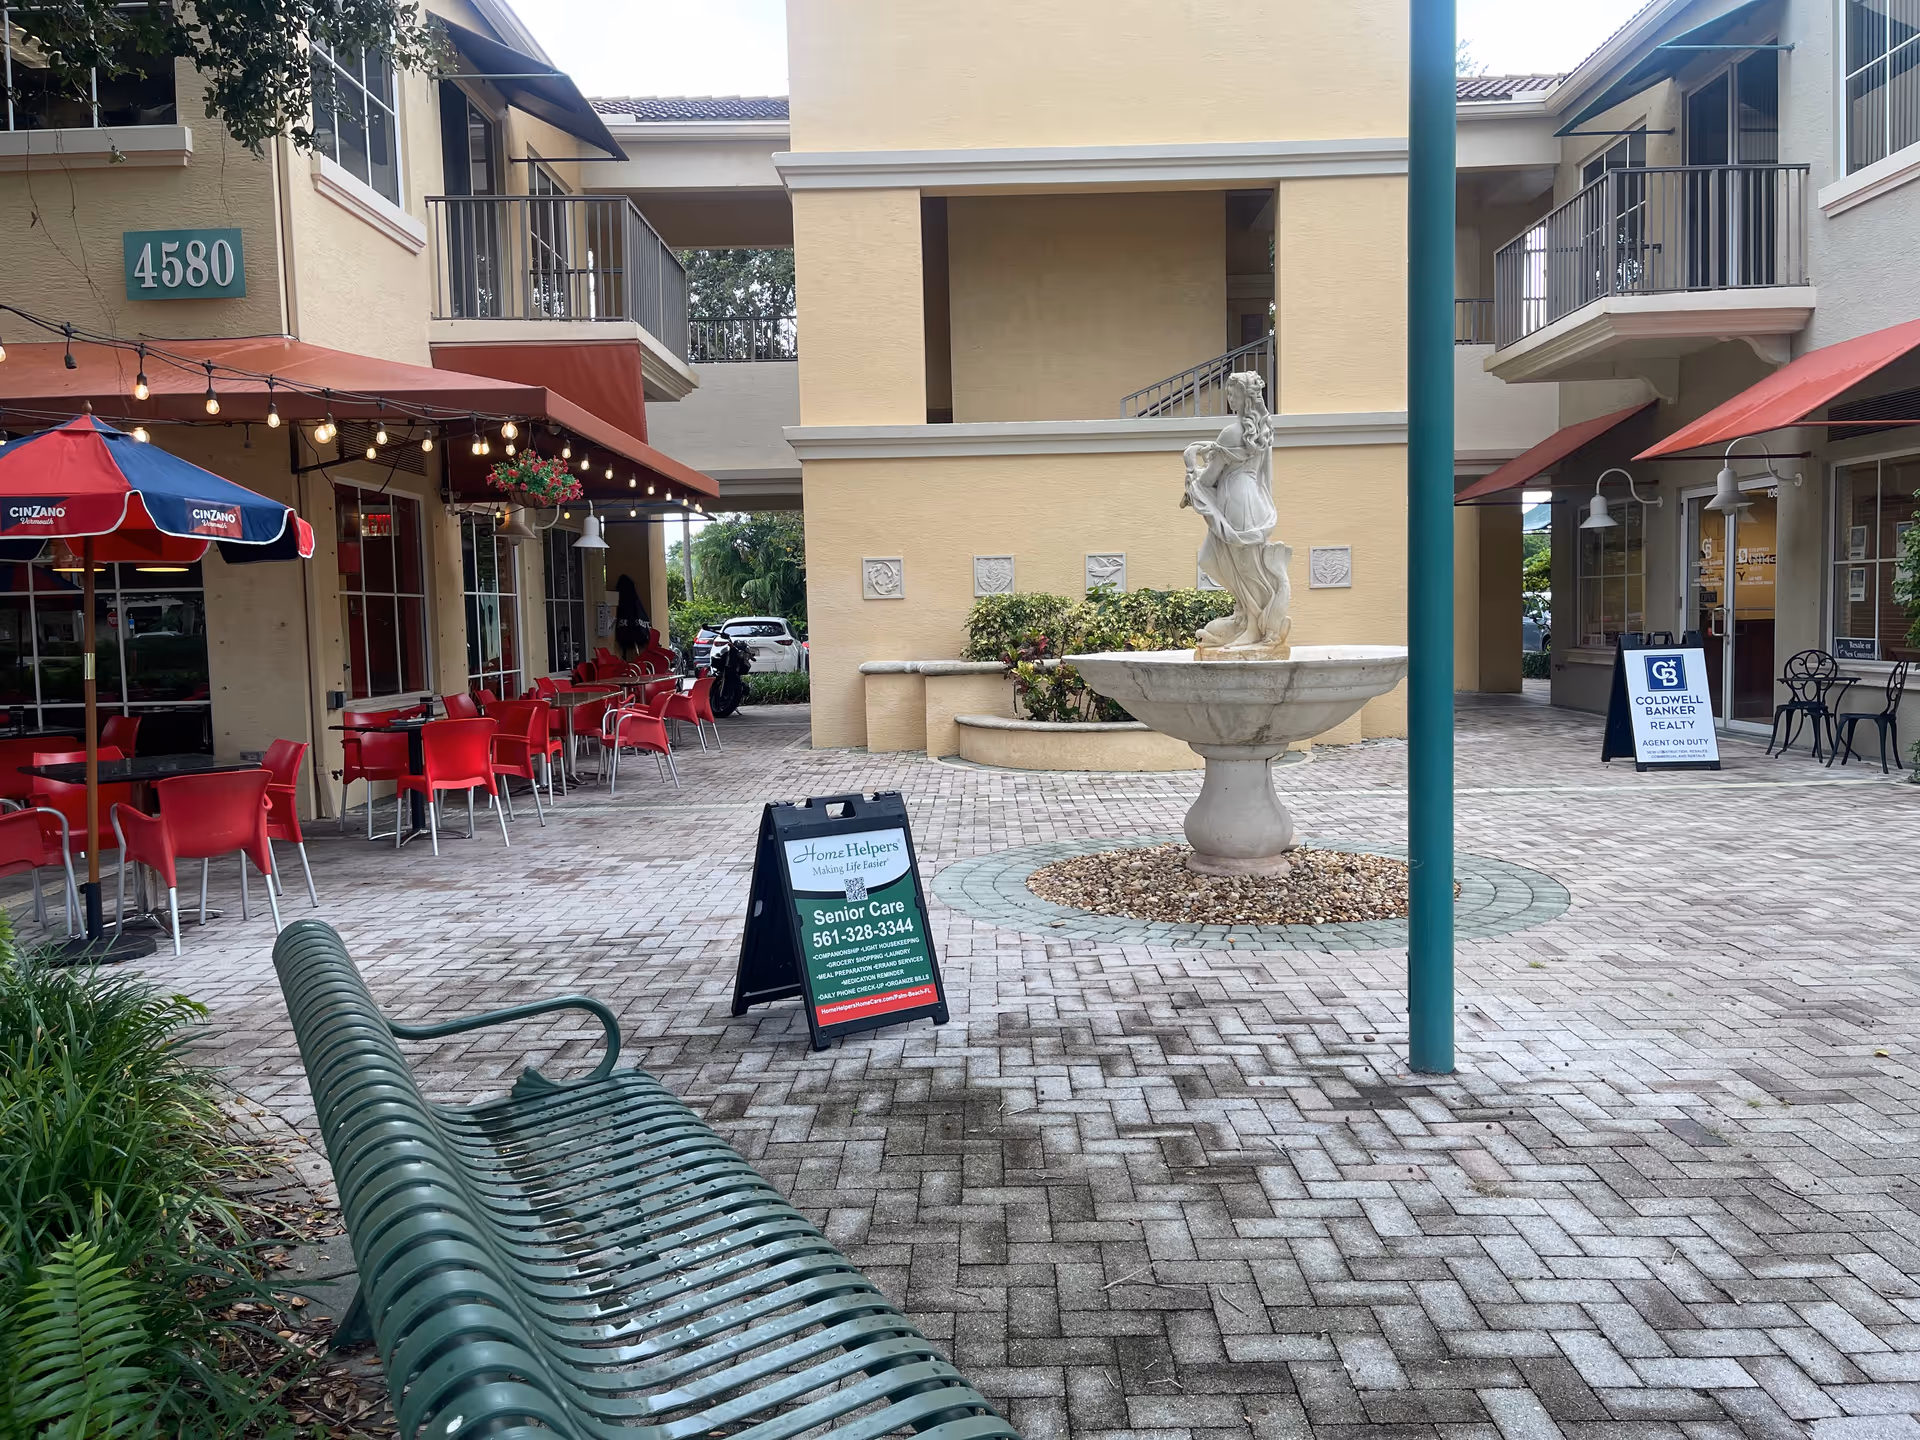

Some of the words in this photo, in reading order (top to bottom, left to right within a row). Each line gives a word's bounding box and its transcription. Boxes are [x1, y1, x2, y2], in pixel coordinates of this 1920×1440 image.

[134, 239, 234, 288] 4580
[9, 505, 65, 518] CINZANO
[193, 508, 236, 523] CINZANO
[1636, 695, 1704, 705] COLDWELL
[1645, 706, 1696, 716] BANKER
[1650, 721, 1695, 730] REALTY
[1642, 739, 1670, 747] AGENT
[1686, 738, 1709, 746] DUTY
[793, 842, 845, 864] Home
[845, 840, 899, 858] Helpers
[812, 864, 844, 876] Making
[846, 862, 861, 873] Life
[863, 859, 887, 870] Easier
[814, 905, 865, 926] Senior
[869, 901, 905, 917] Care
[813, 917, 914, 948] 561-328-3344
[879, 937, 920, 950] HOUSEKEEPING
[855, 953, 884, 963] SHOPPING
[834, 965, 873, 977] PREPARATION
[898, 955, 924, 965] SERVICES
[877, 969, 904, 980] REMINDER
[836, 987, 856, 997] PHONE
[856, 982, 884, 993] CHECK-UP
[914, 973, 930, 982] BILLS
